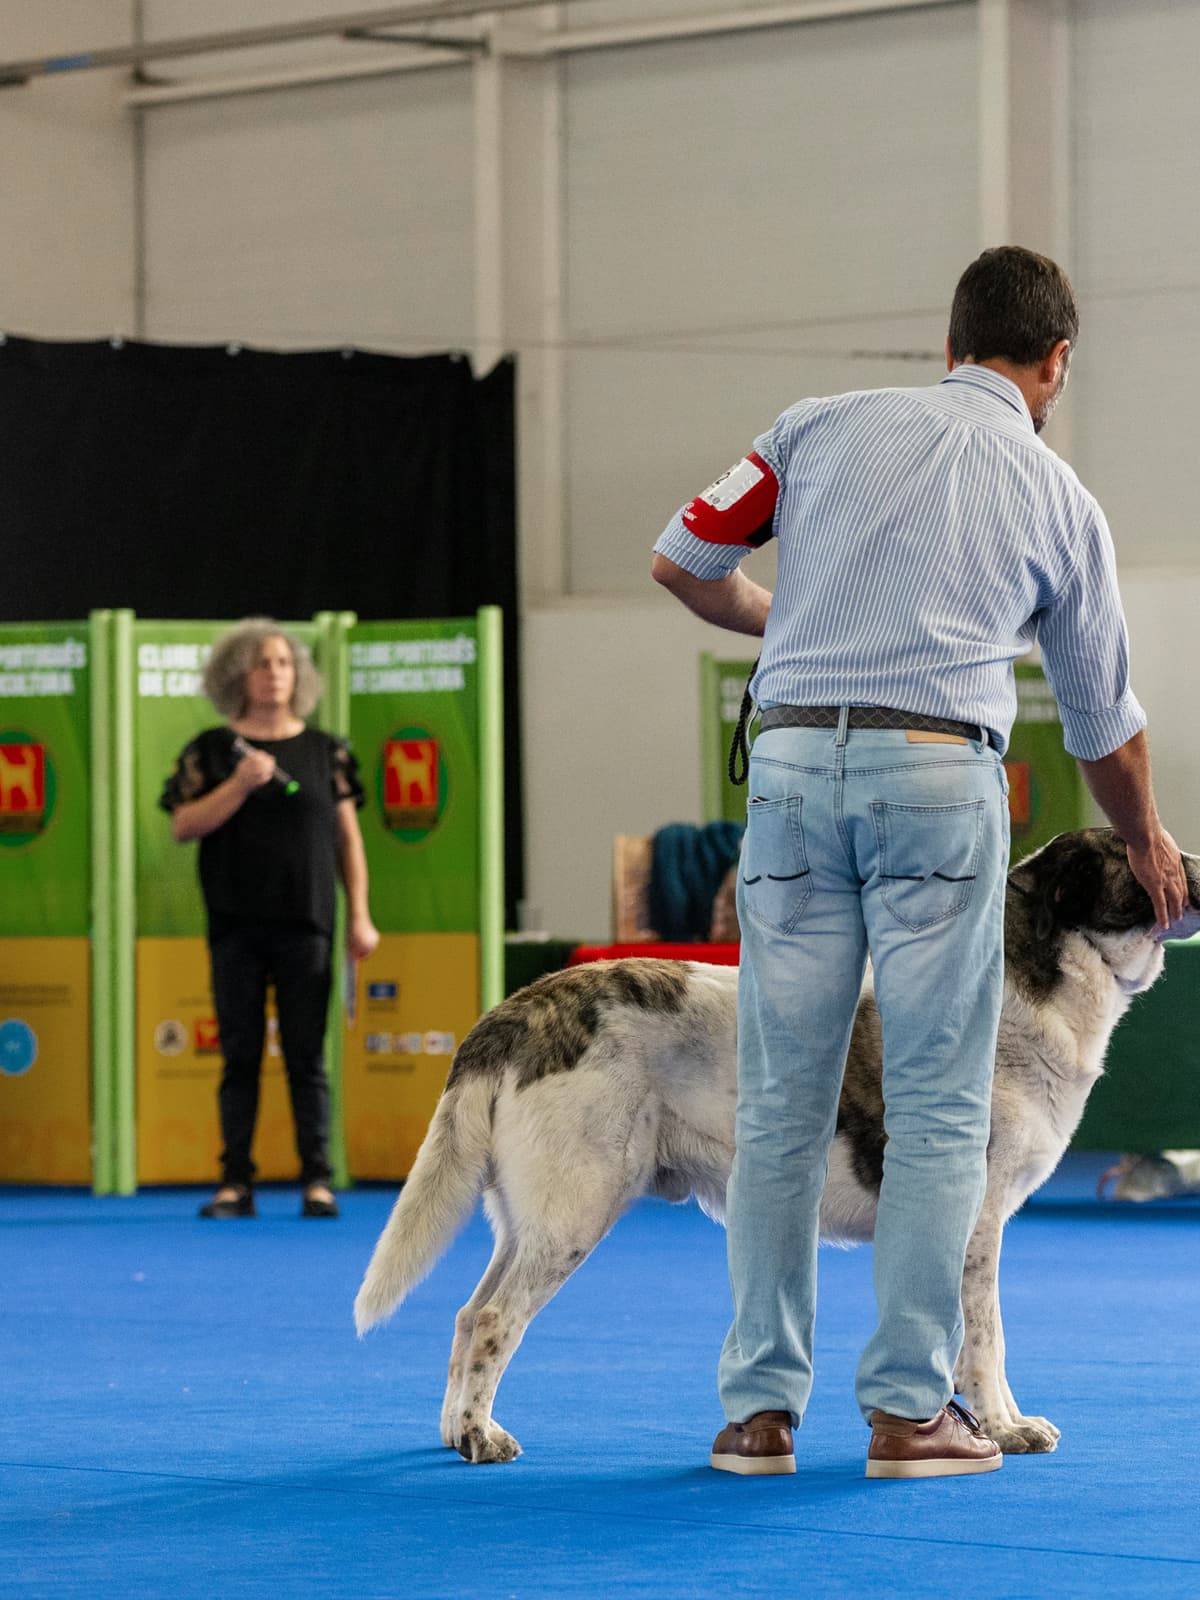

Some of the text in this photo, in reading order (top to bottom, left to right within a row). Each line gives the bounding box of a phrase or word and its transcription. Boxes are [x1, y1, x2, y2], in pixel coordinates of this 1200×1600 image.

[138, 643, 198, 669] CLUBE
[391, 633, 477, 664] PORTUGUÊS
[138, 671, 164, 696] DE
